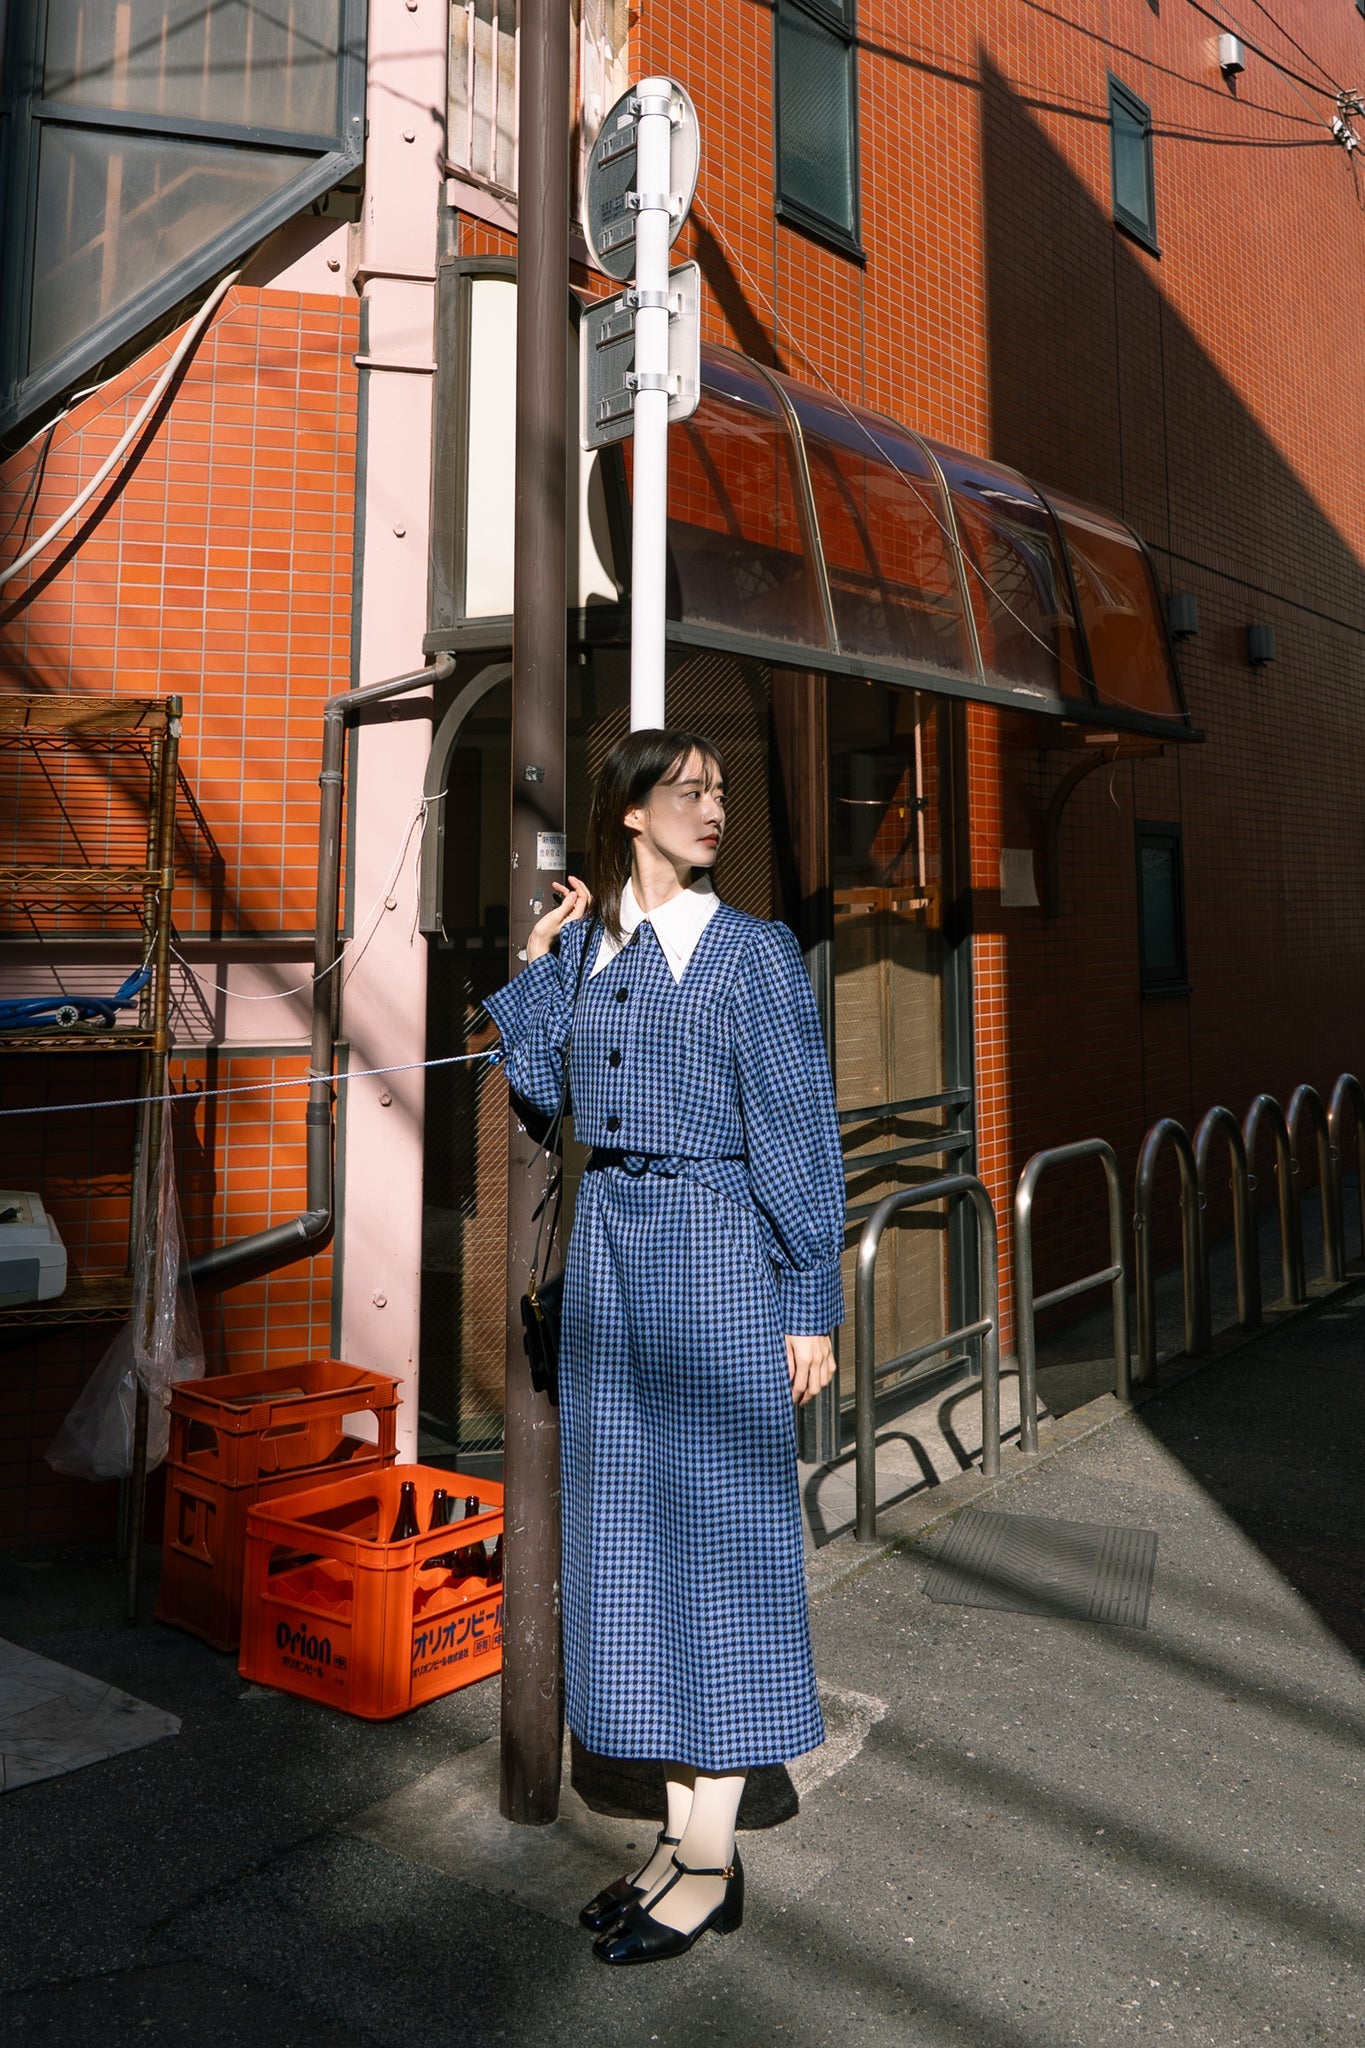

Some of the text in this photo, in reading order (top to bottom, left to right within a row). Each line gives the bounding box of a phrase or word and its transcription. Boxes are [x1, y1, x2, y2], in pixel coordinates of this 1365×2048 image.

[276, 1622, 331, 1665] Orion
[281, 1656, 324, 1678] オリオンビール
